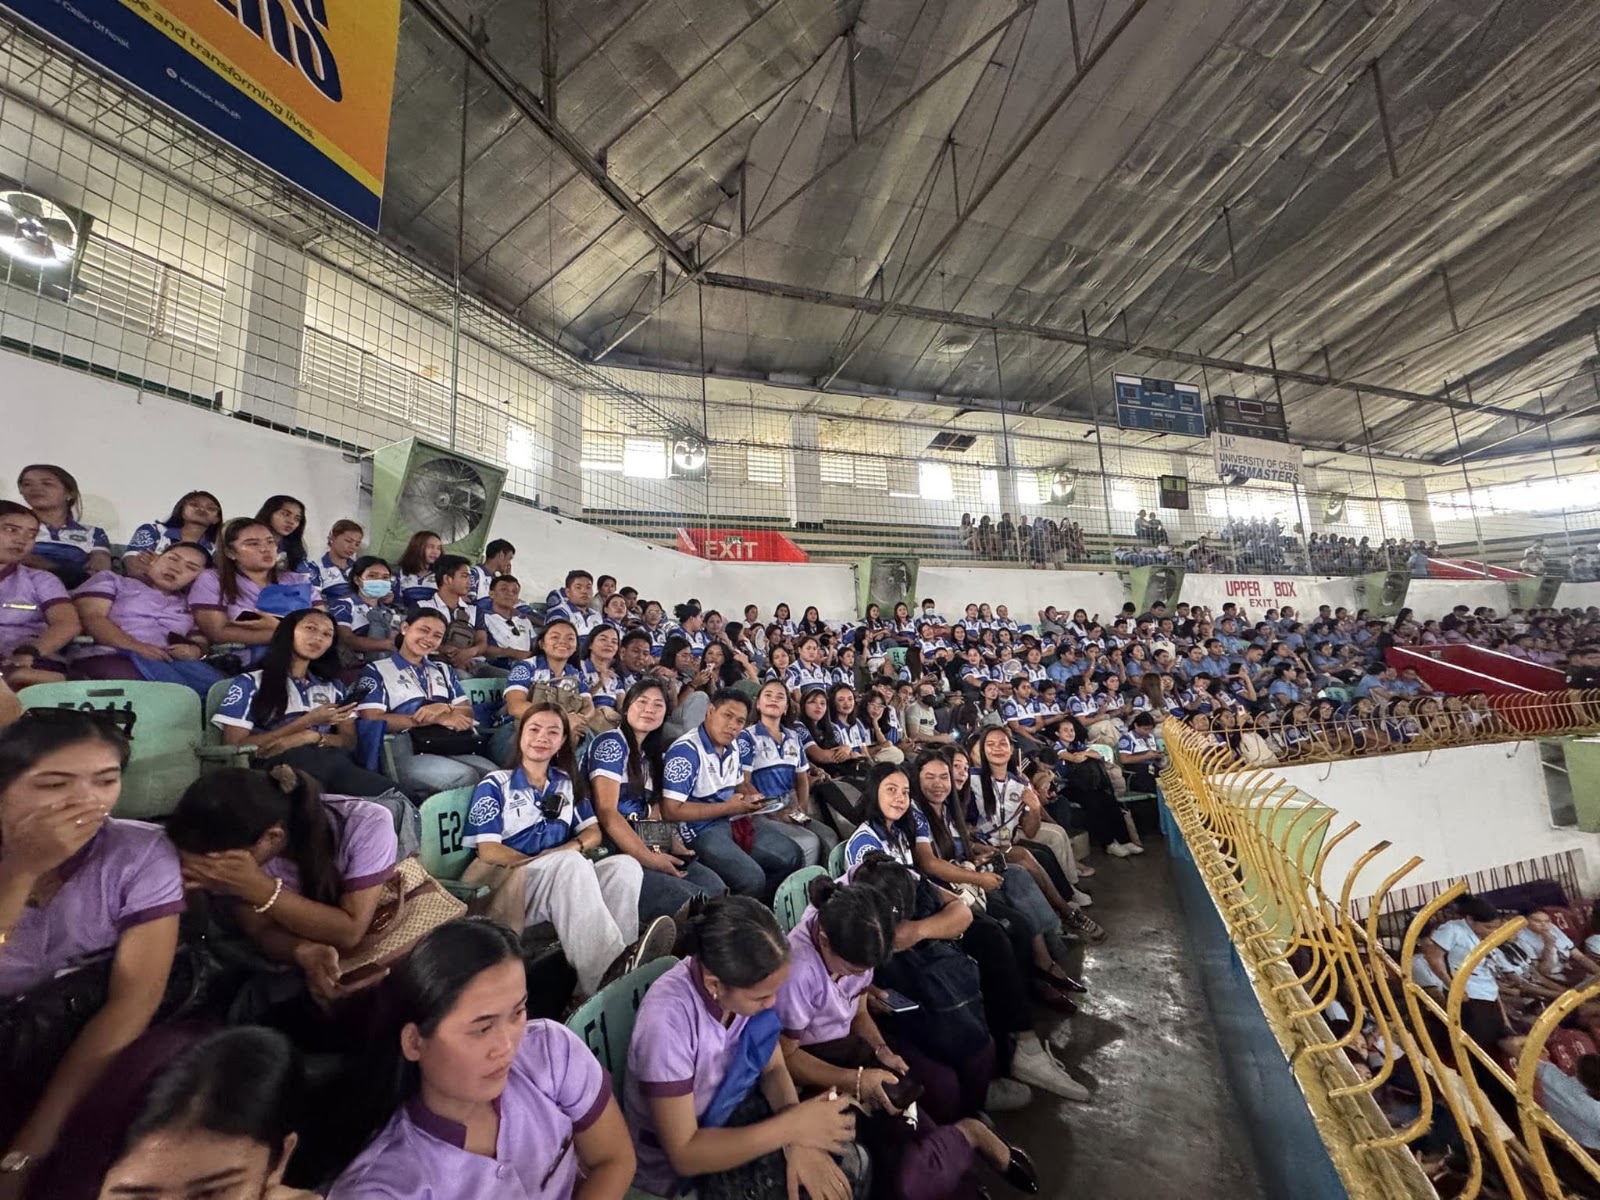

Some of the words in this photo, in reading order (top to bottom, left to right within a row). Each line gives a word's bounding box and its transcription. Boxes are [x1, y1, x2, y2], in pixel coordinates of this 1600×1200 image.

[153, 12, 187, 40] and
[190, 37, 283, 115] transforming
[285, 111, 315, 140] lives.
[1219, 453, 1265, 468] UNIVERSITY
[1266, 459, 1277, 468] OF
[1278, 461, 1299, 472] CEBU
[1220, 463, 1300, 483] WEBMASTERS
[705, 540, 758, 559] EXIT
[1225, 580, 1262, 597] UPPER
[1273, 581, 1297, 597] BOX
[1249, 598, 1273, 608] EXIT
[438, 811, 463, 856] E2
